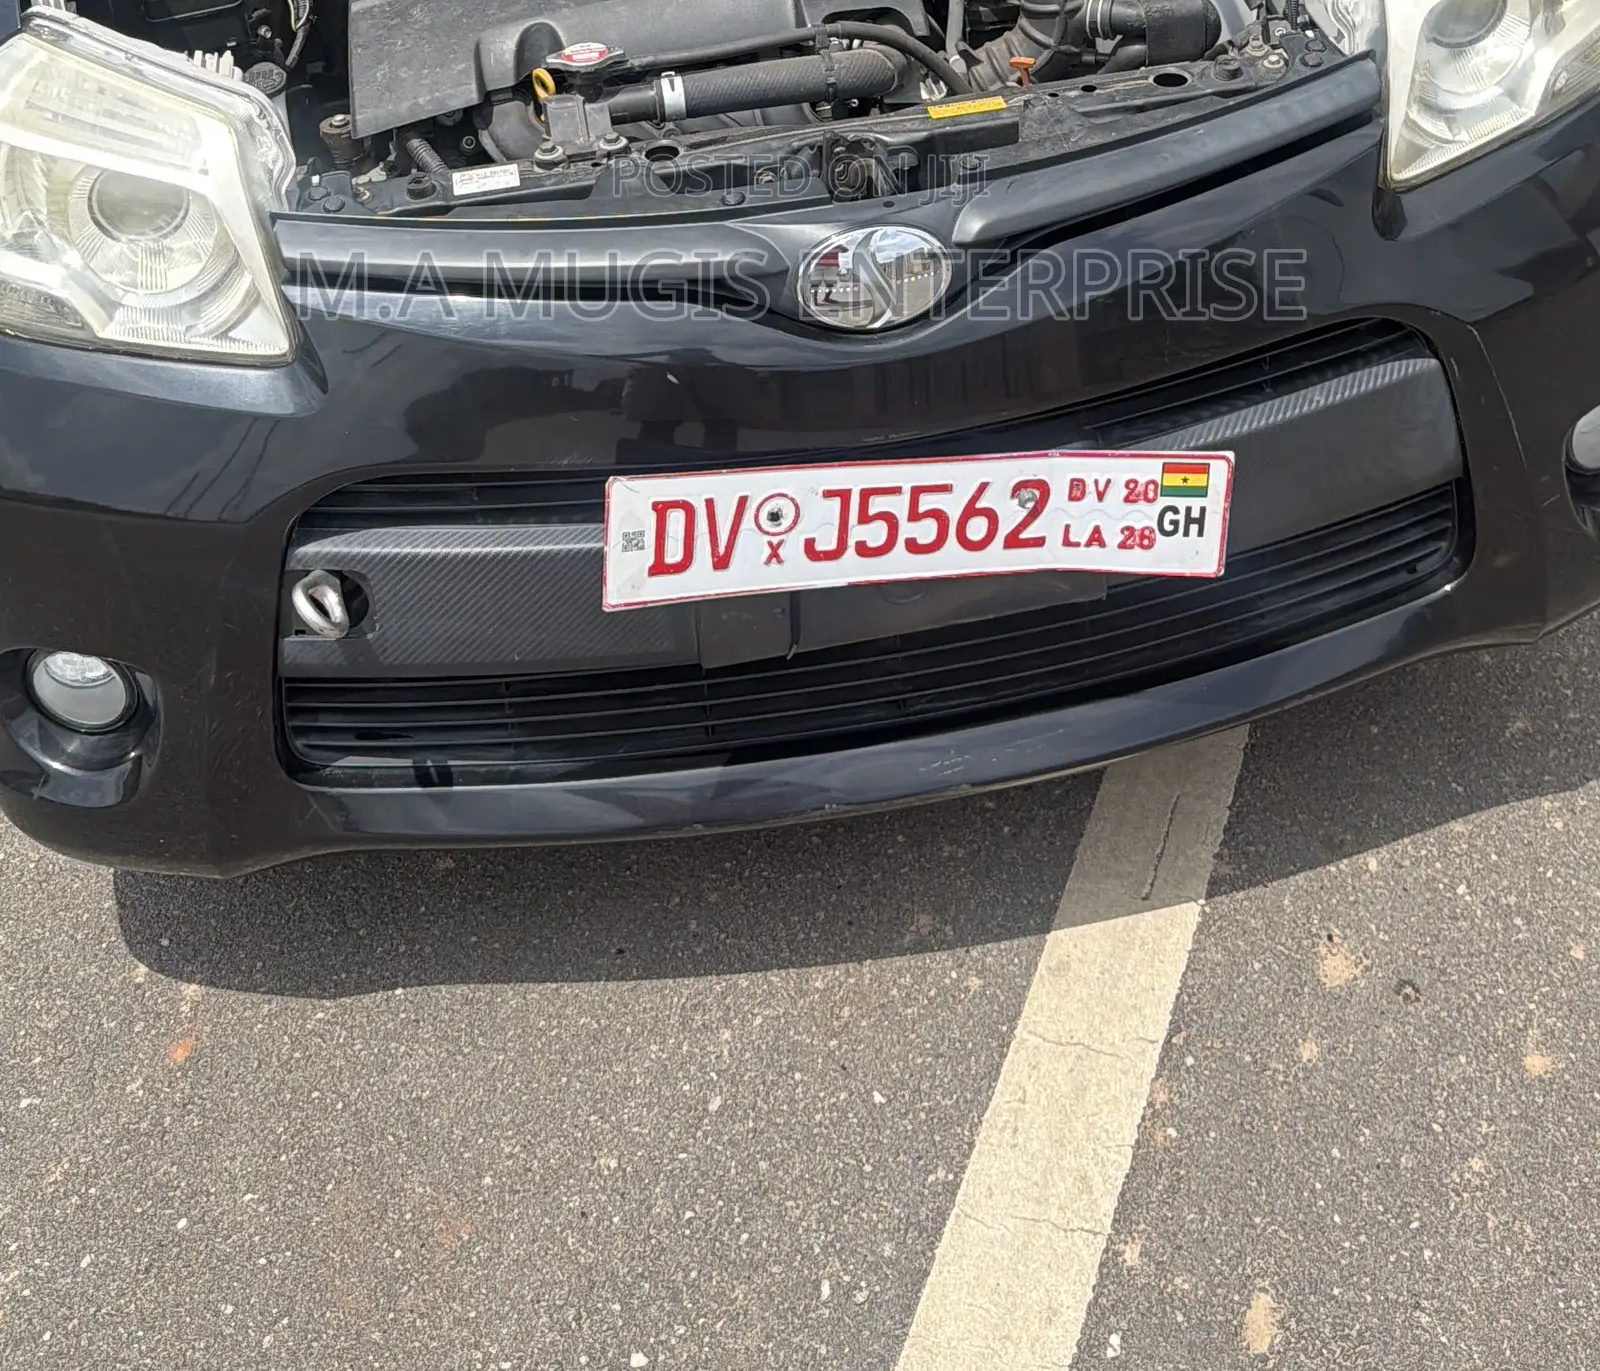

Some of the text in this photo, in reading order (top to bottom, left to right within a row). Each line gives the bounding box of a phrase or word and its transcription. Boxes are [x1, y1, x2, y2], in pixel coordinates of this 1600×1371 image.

[1067, 477, 1160, 504] DV 20
[648, 478, 1051, 577] DV J5562
[1061, 523, 1107, 549] LA
[1156, 505, 1207, 538] GH
